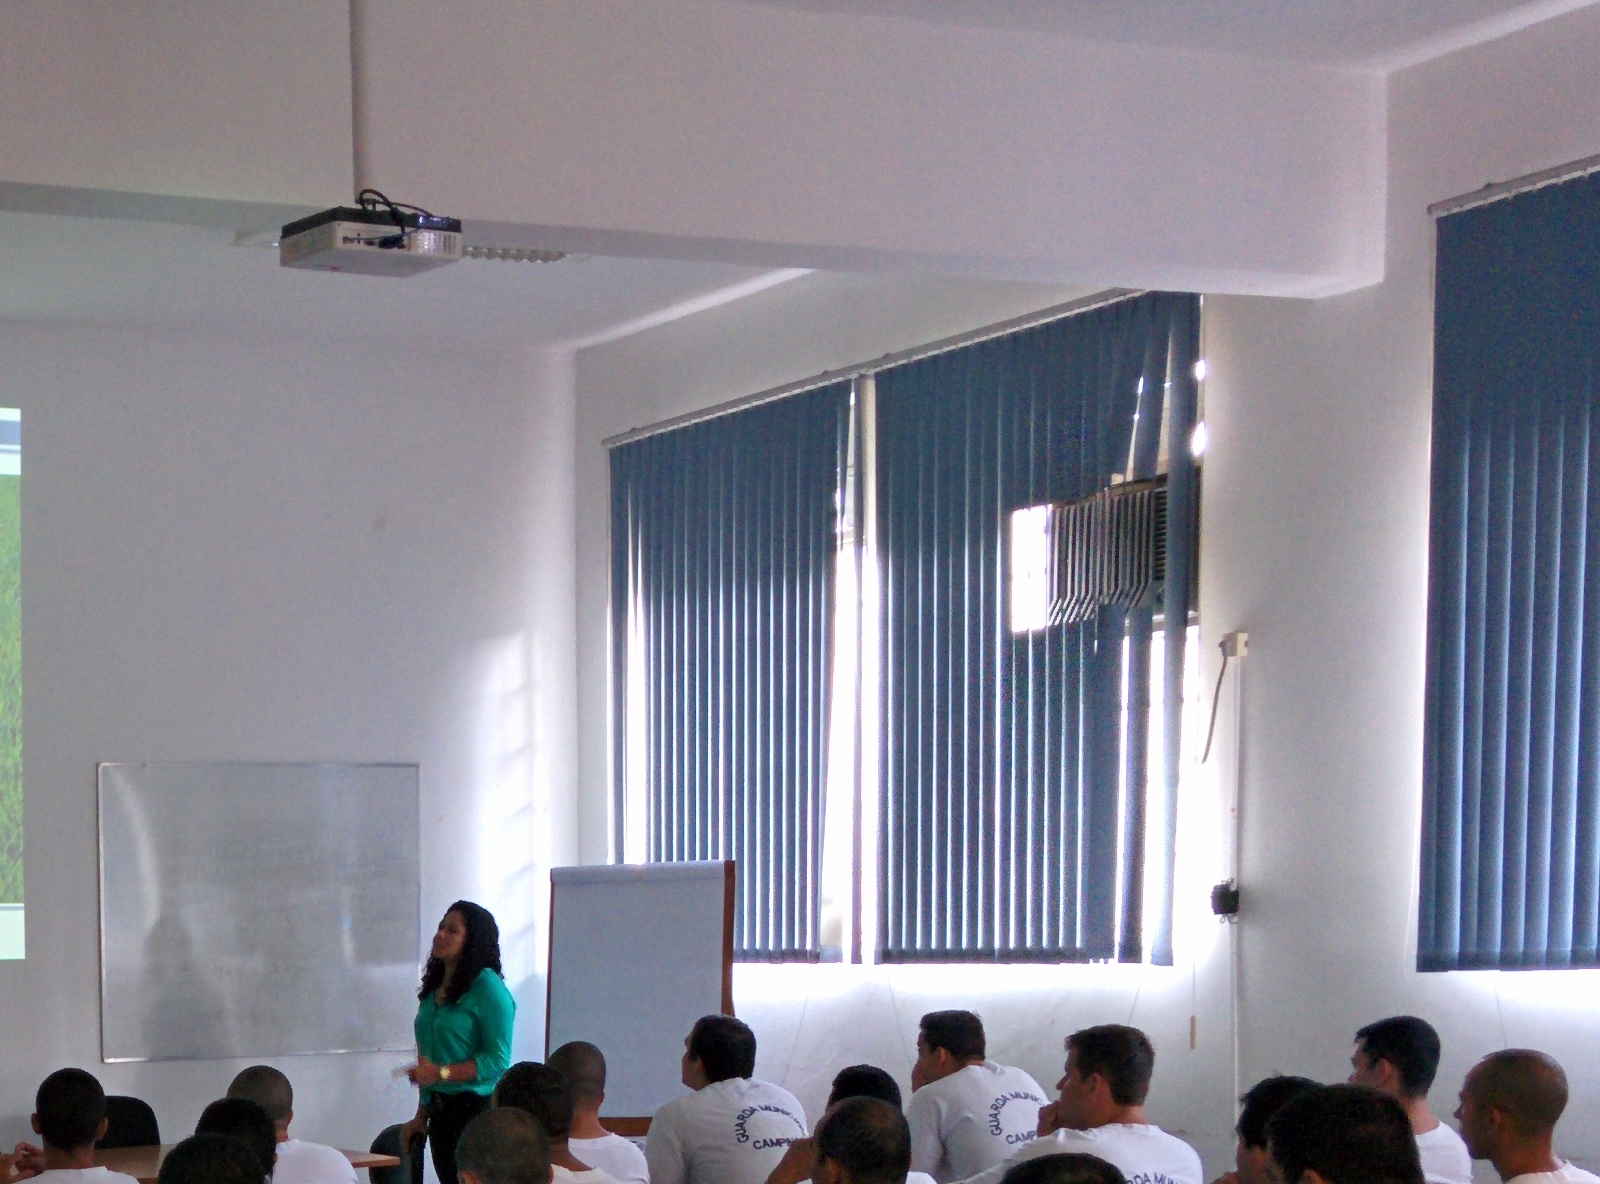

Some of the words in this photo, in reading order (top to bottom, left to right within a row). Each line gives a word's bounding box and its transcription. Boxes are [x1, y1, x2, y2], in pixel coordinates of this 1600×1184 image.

[734, 1106, 760, 1143] GUARDA
[988, 1094, 1011, 1136] GUARDA
[1005, 1130, 1037, 1145] CAMP
